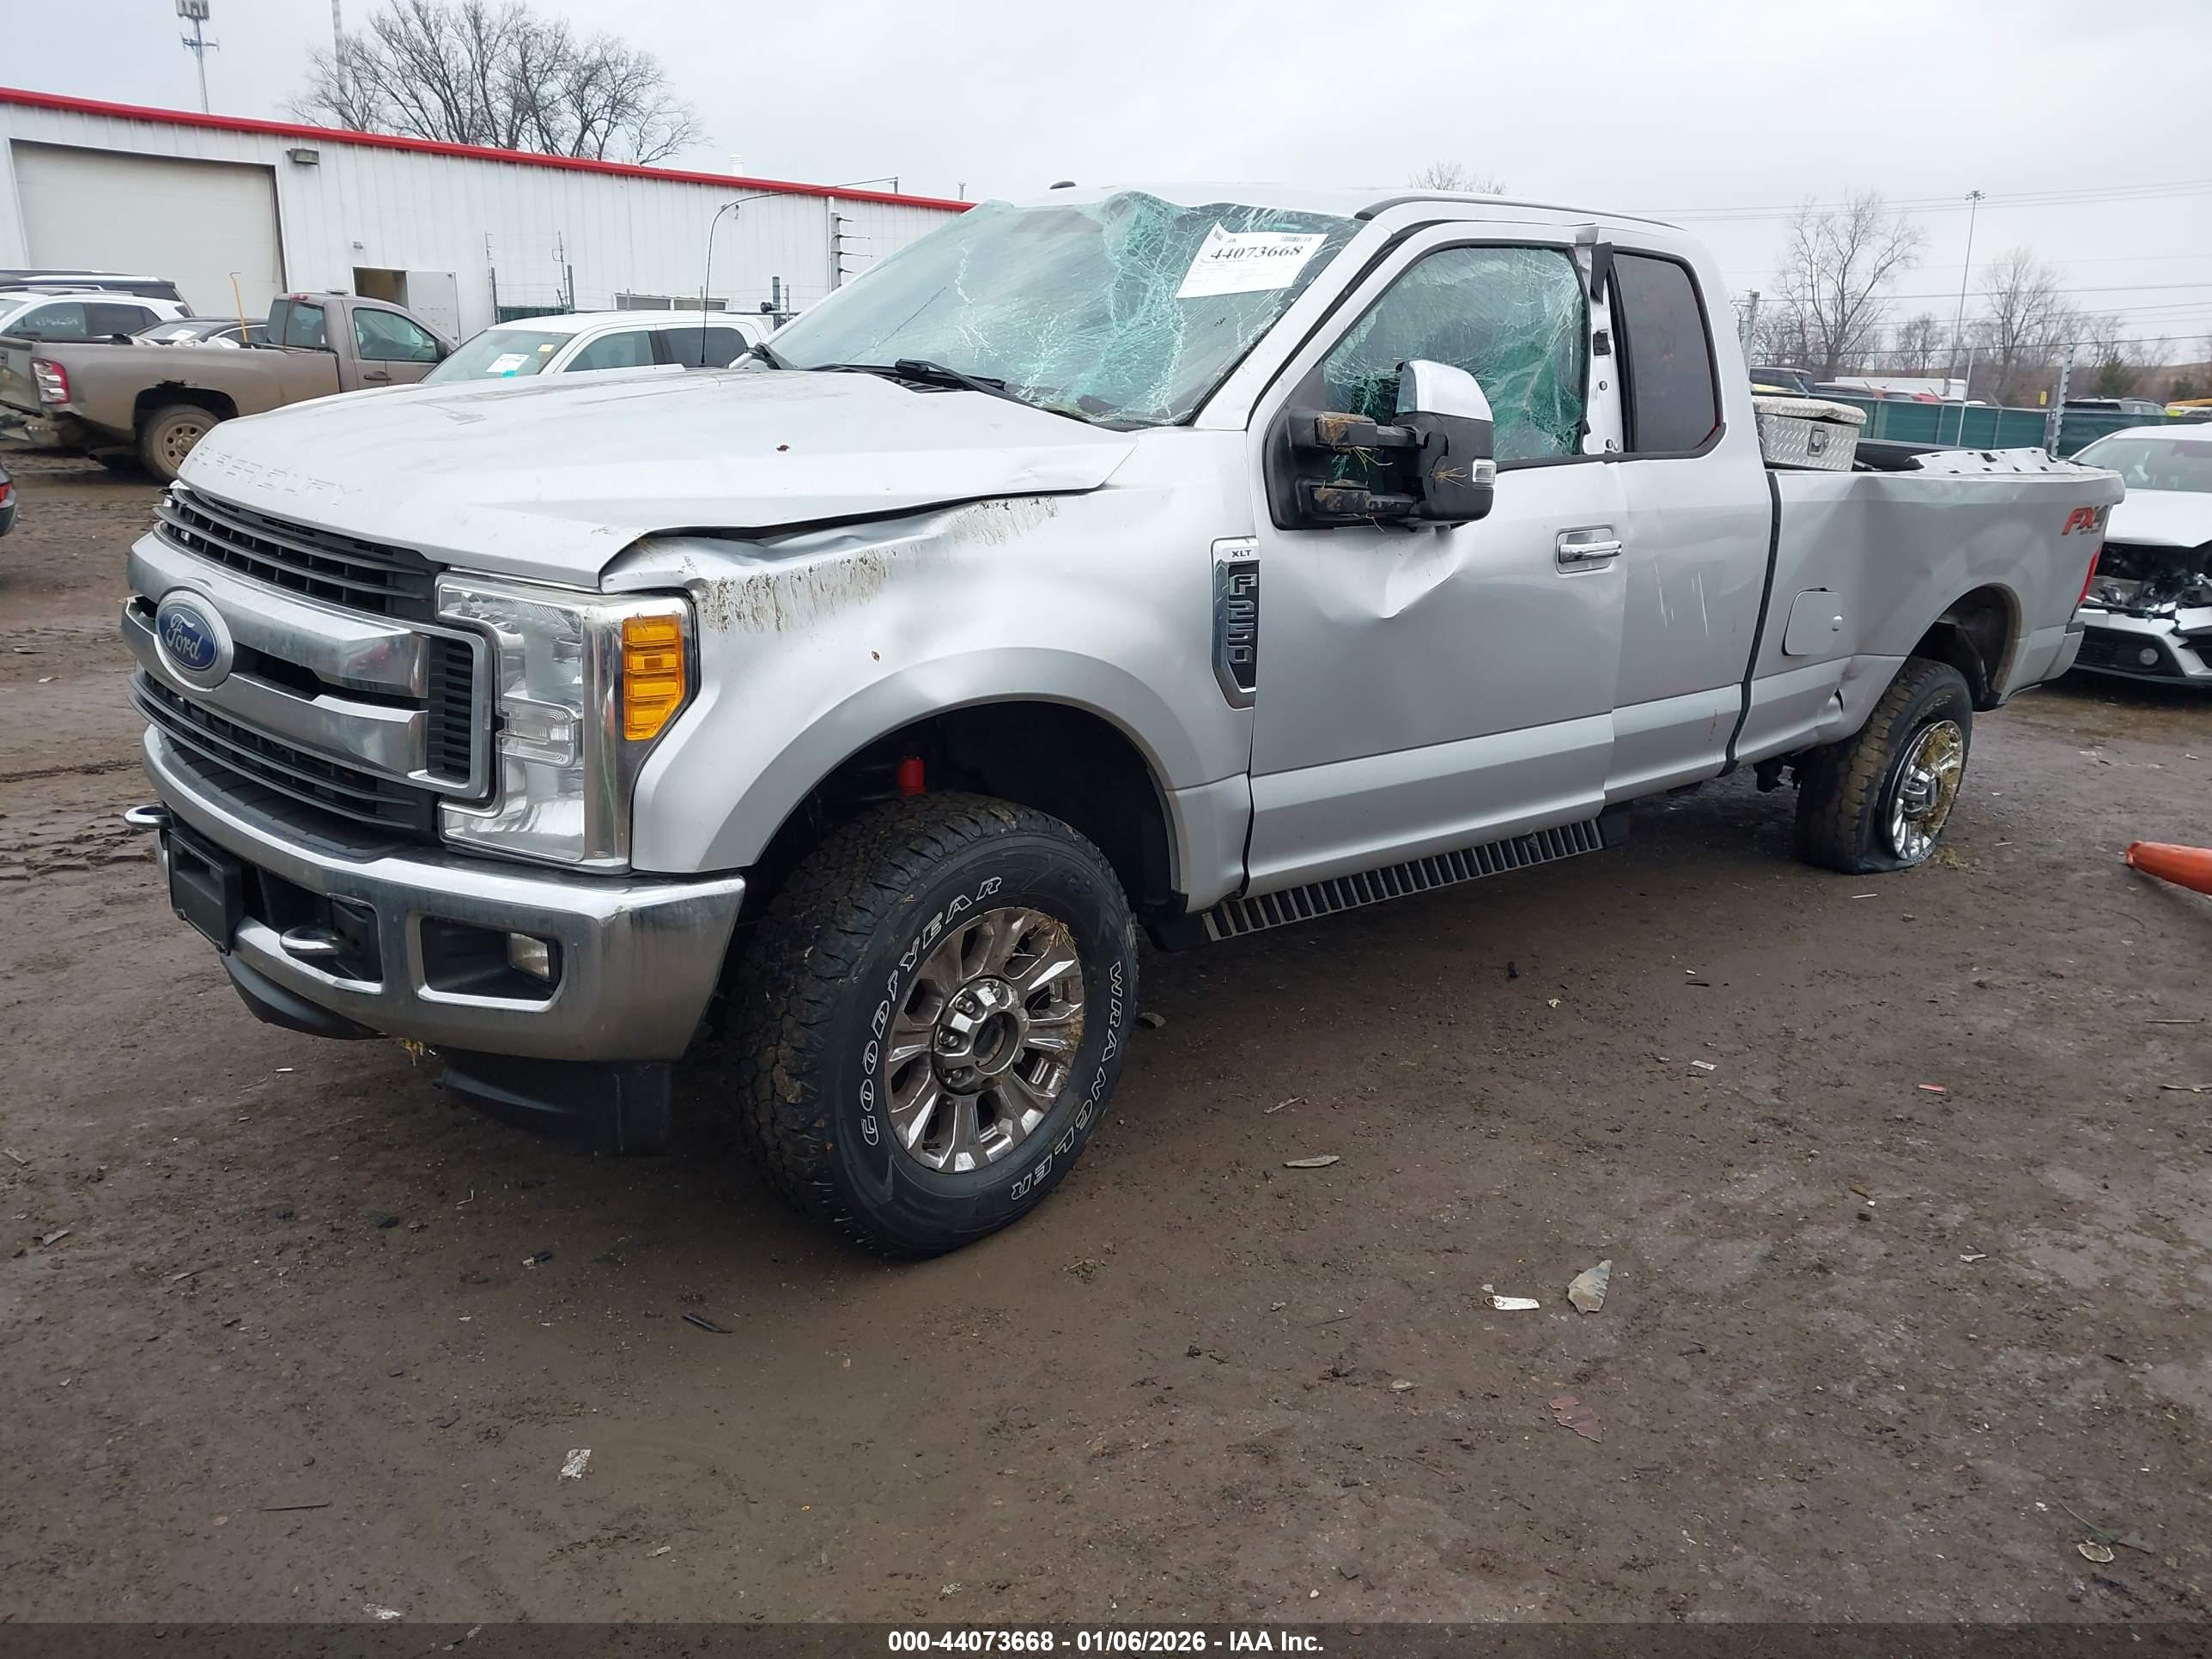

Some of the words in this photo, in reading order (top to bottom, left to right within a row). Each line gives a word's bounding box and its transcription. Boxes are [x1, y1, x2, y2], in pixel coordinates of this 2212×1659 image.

[1209, 245, 1304, 260] 44073668
[2061, 504, 2110, 537] FX4
[1231, 549, 1252, 558] XLT
[165, 612, 204, 661] Ford
[859, 875, 1003, 1147] GOODYEAR
[1010, 960, 1125, 1202] WRANGLER
